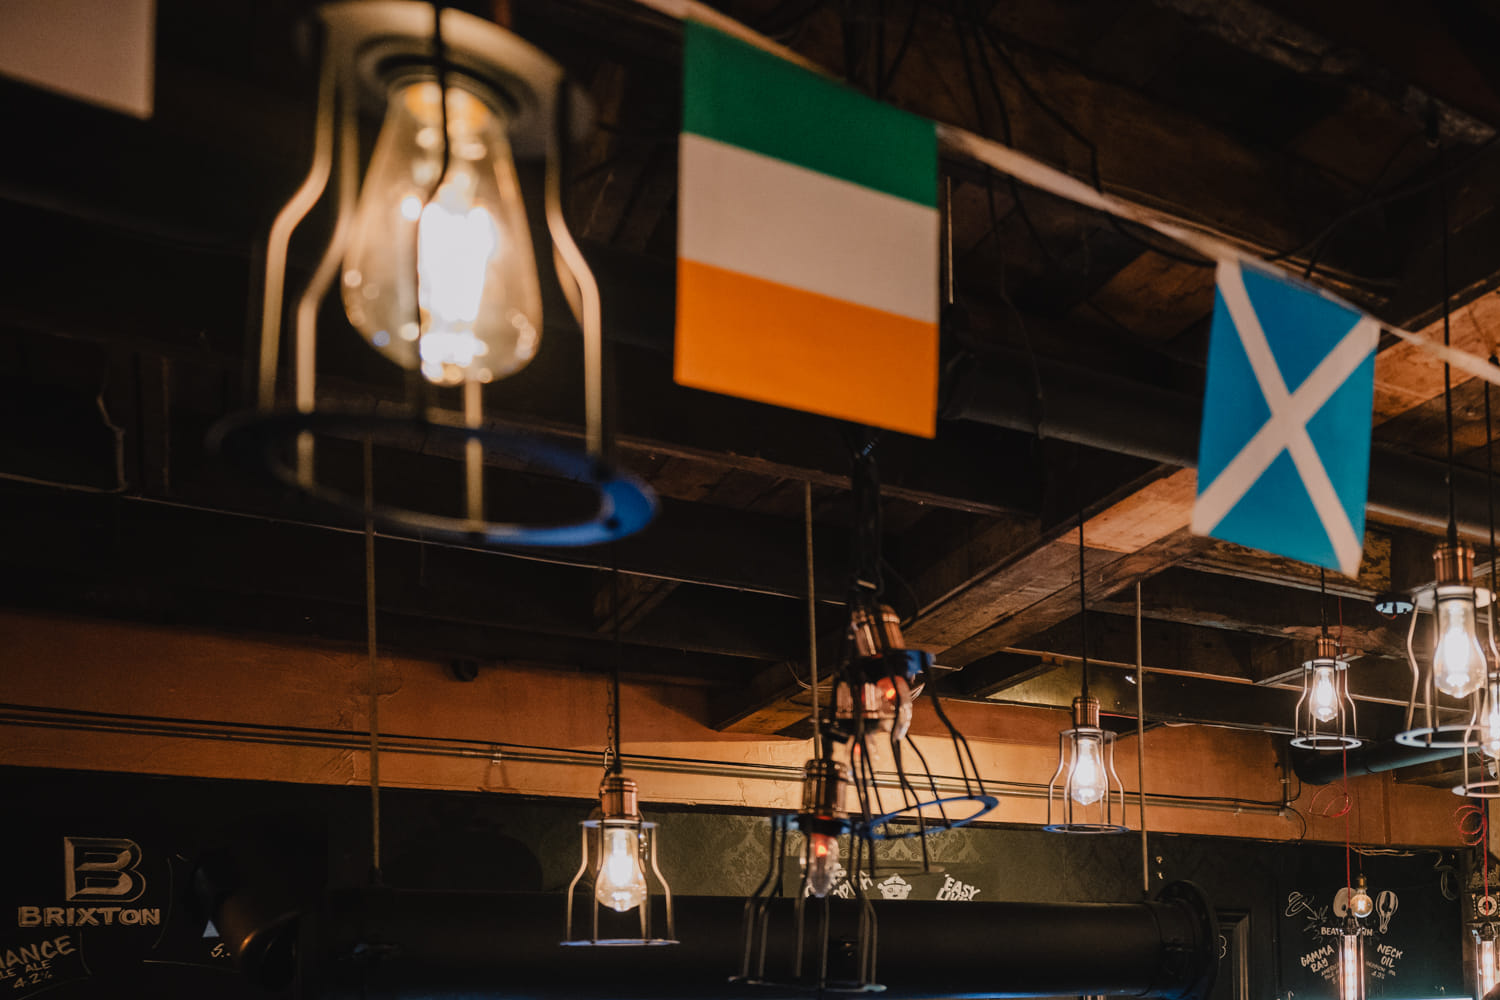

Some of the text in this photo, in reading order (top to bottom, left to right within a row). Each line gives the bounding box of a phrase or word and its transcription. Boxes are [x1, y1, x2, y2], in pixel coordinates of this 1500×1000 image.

[944, 874, 981, 899] EASY
[18, 905, 161, 928] BRIXTON
[1300, 944, 1335, 967] GAMMA
[1376, 944, 1403, 959] NECK
[25, 960, 52, 974] ALE
[1310, 958, 1329, 973] RAY
[1381, 956, 1396, 968] OIL
